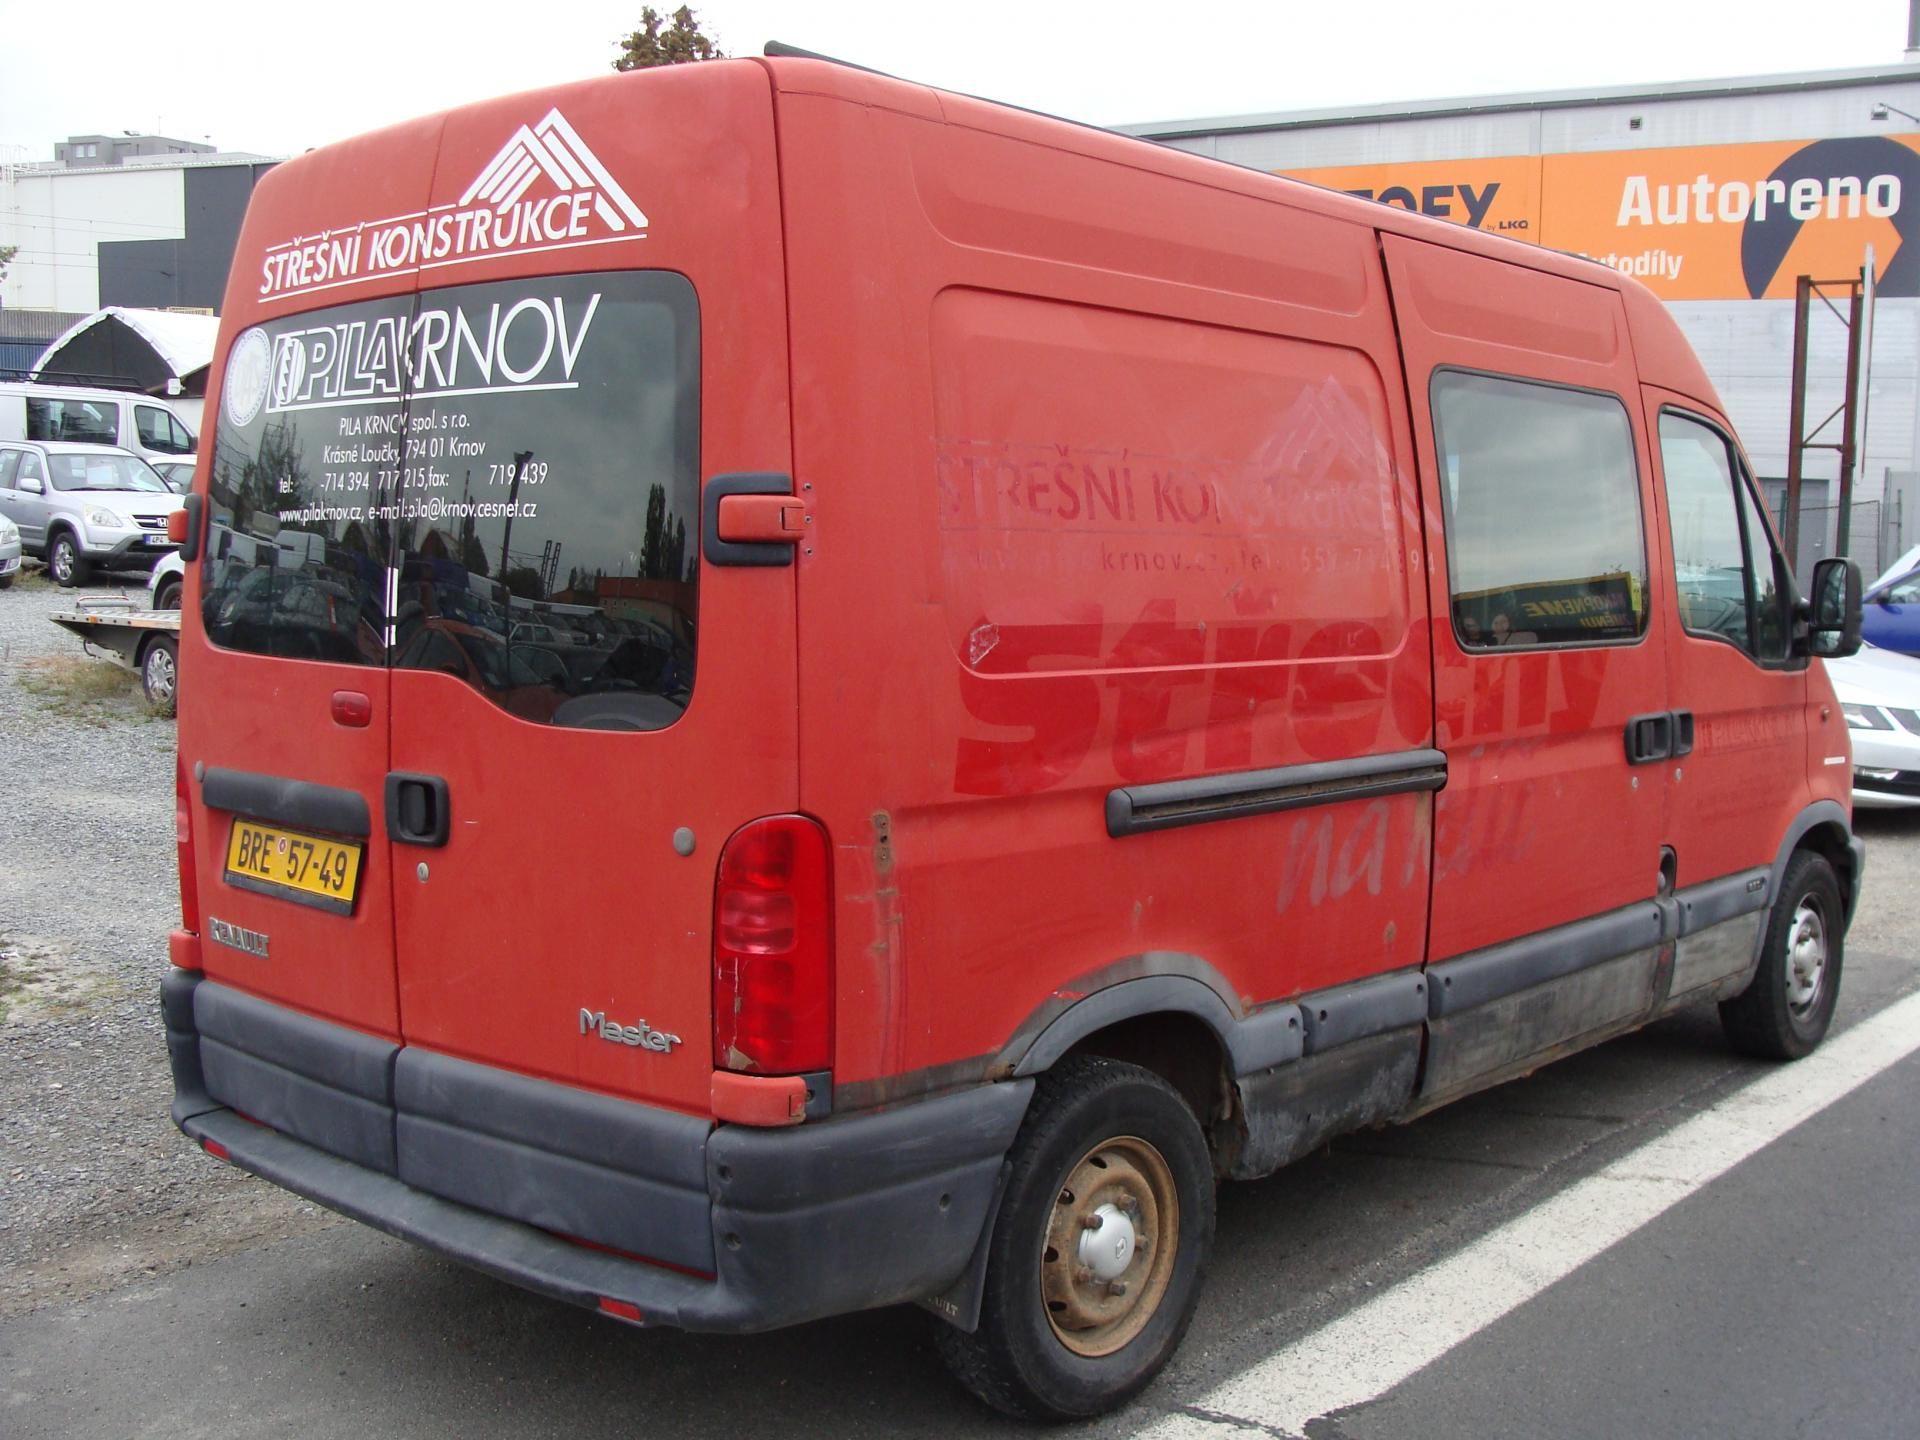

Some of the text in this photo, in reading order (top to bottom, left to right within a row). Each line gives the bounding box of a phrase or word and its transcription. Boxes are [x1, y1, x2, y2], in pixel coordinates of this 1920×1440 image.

[1616, 174, 1901, 226] Autoreno
[259, 192, 594, 295] STŘEŠNÍ KONSTRUKCE
[1499, 220, 1529, 230] LKQ
[339, 416, 361, 436] PILA
[412, 409, 438, 433] spol.
[441, 415, 448, 429] s
[451, 413, 470, 428] r.o.
[323, 437, 486, 466] Krásné Loučky, 794 01 Krnov
[347, 471, 370, 491] 394
[378, 470, 400, 490] 717
[489, 464, 516, 485] 719
[519, 462, 548, 485] 439
[238, 829, 348, 891] BRE 57-49
[209, 916, 270, 960] RENAULT
[580, 1007, 682, 1053] Master
